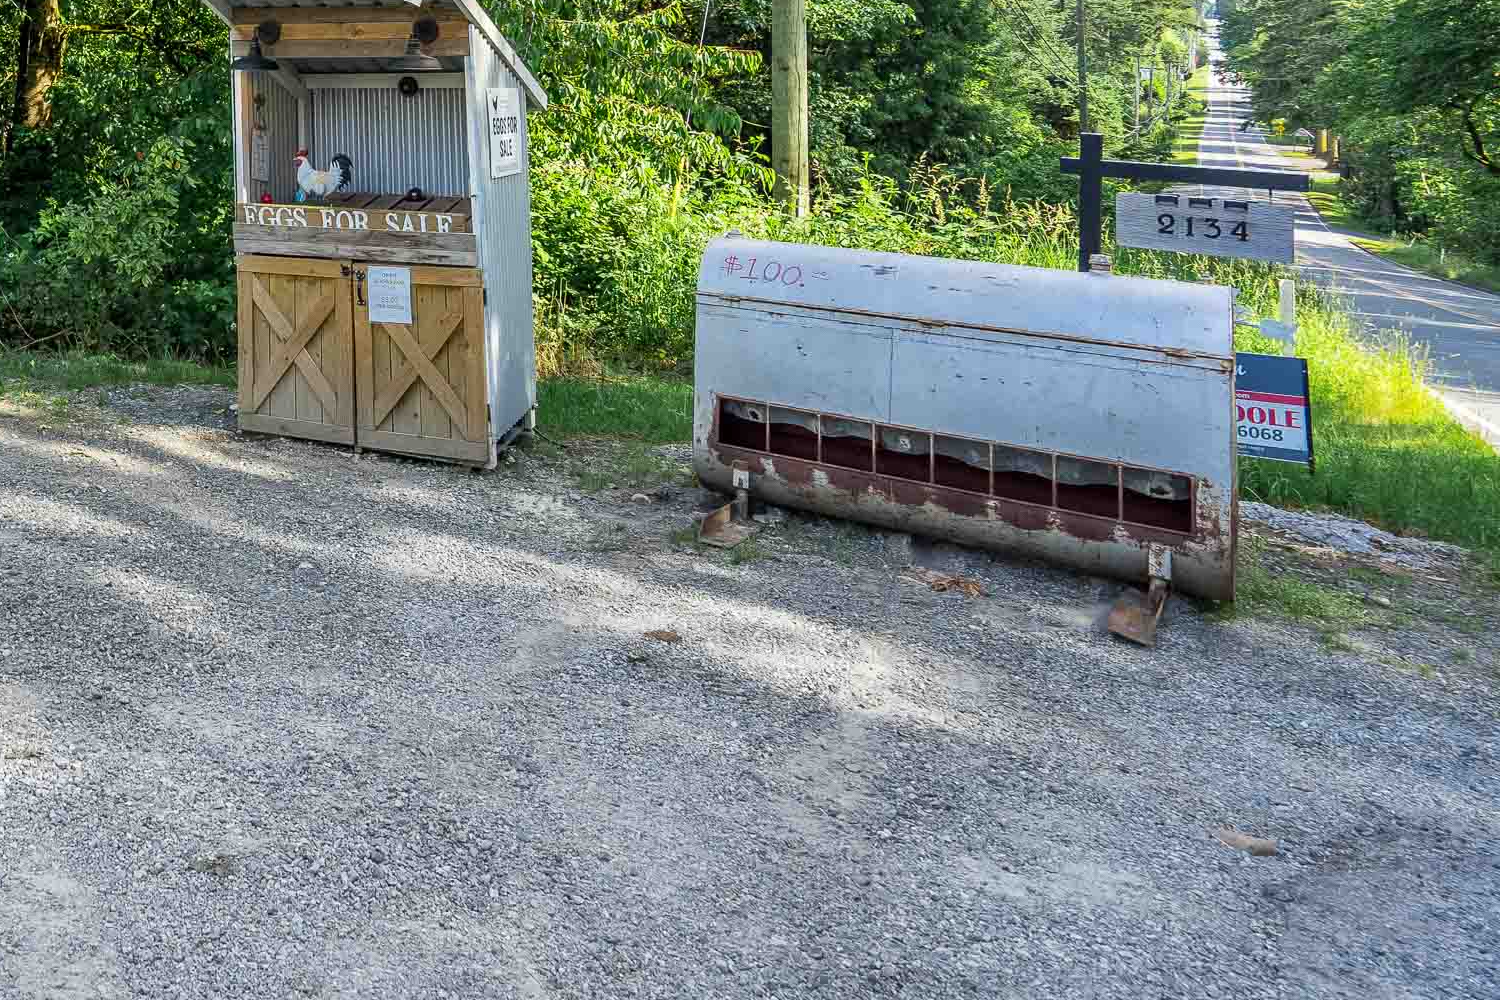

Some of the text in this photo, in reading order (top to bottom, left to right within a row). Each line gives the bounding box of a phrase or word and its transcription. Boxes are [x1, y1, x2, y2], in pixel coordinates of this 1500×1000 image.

[493, 115, 518, 135] EGGS FOR
[500, 139, 512, 157] SALE
[243, 206, 453, 233] EGGS FOR SALE
[1156, 213, 1251, 242] 2134
